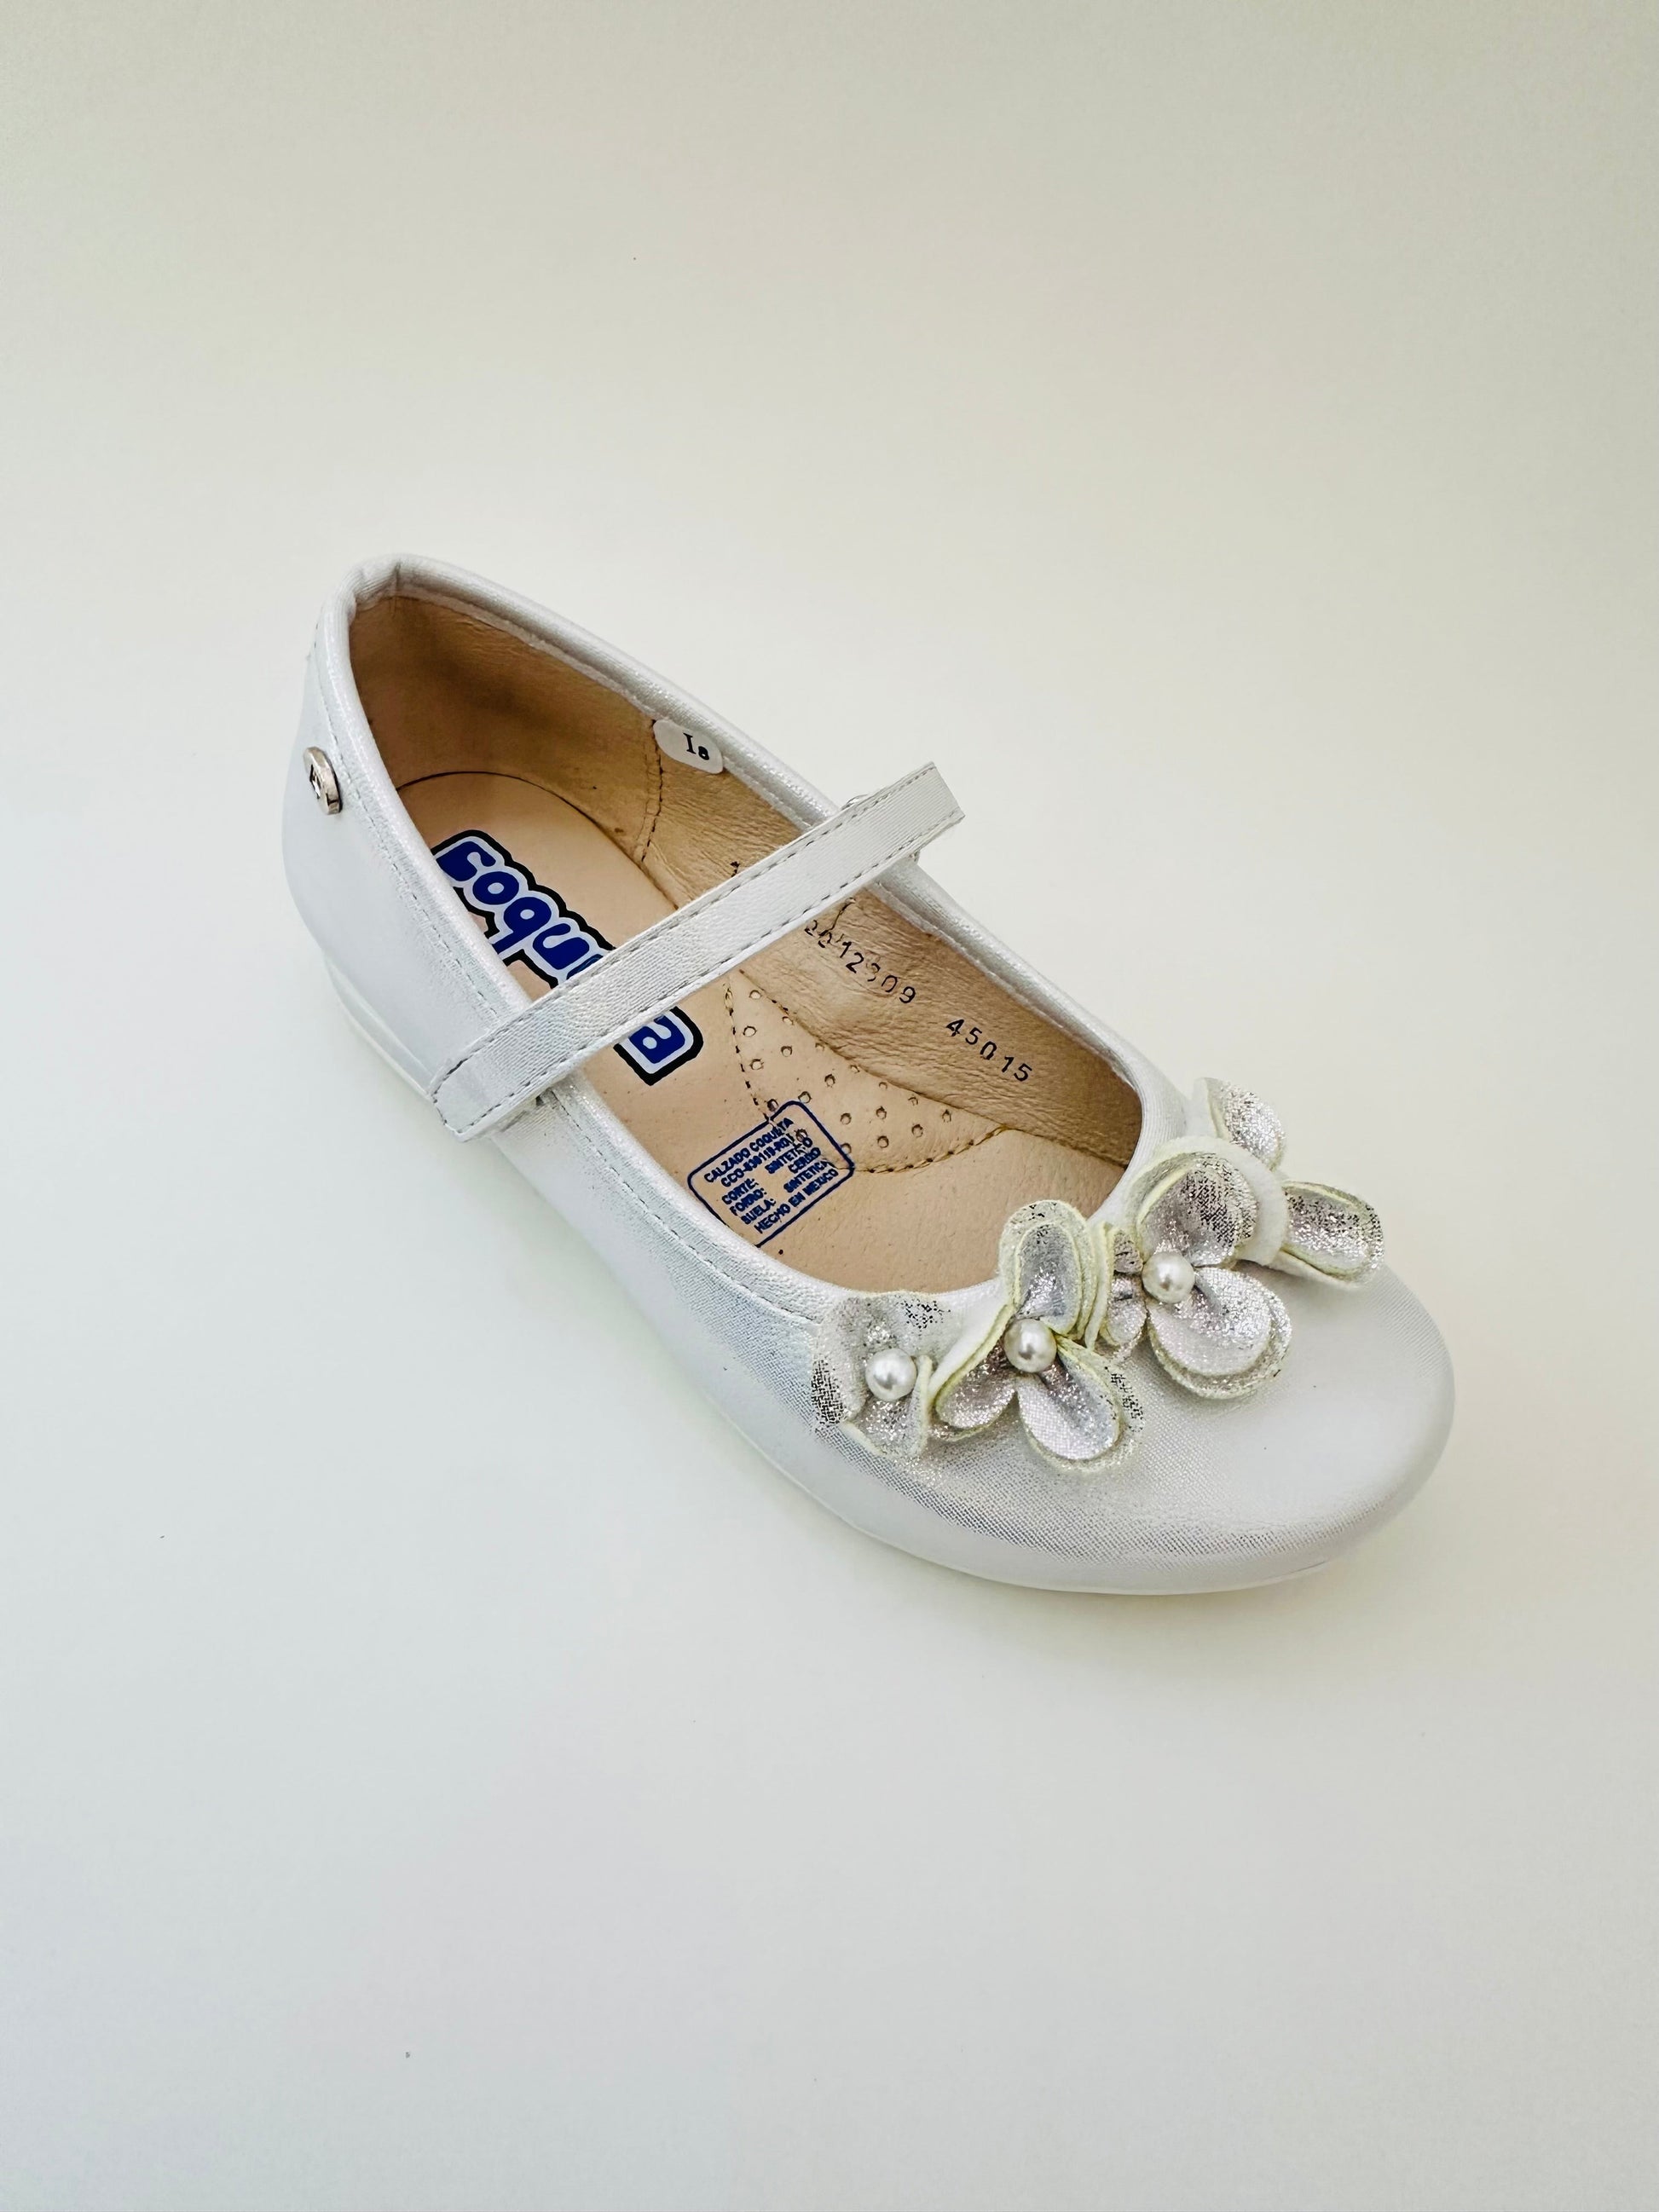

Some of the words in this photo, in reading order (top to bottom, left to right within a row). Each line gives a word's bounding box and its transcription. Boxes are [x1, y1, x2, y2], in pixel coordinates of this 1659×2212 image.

[432, 837, 692, 1072] coqua
[945, 1019, 1033, 1083] 45015
[703, 1147, 751, 1183] CALZADO
[749, 1118, 794, 1152] COQUETA
[754, 1203, 791, 1234] HECHO
[788, 1192, 806, 1208] EN
